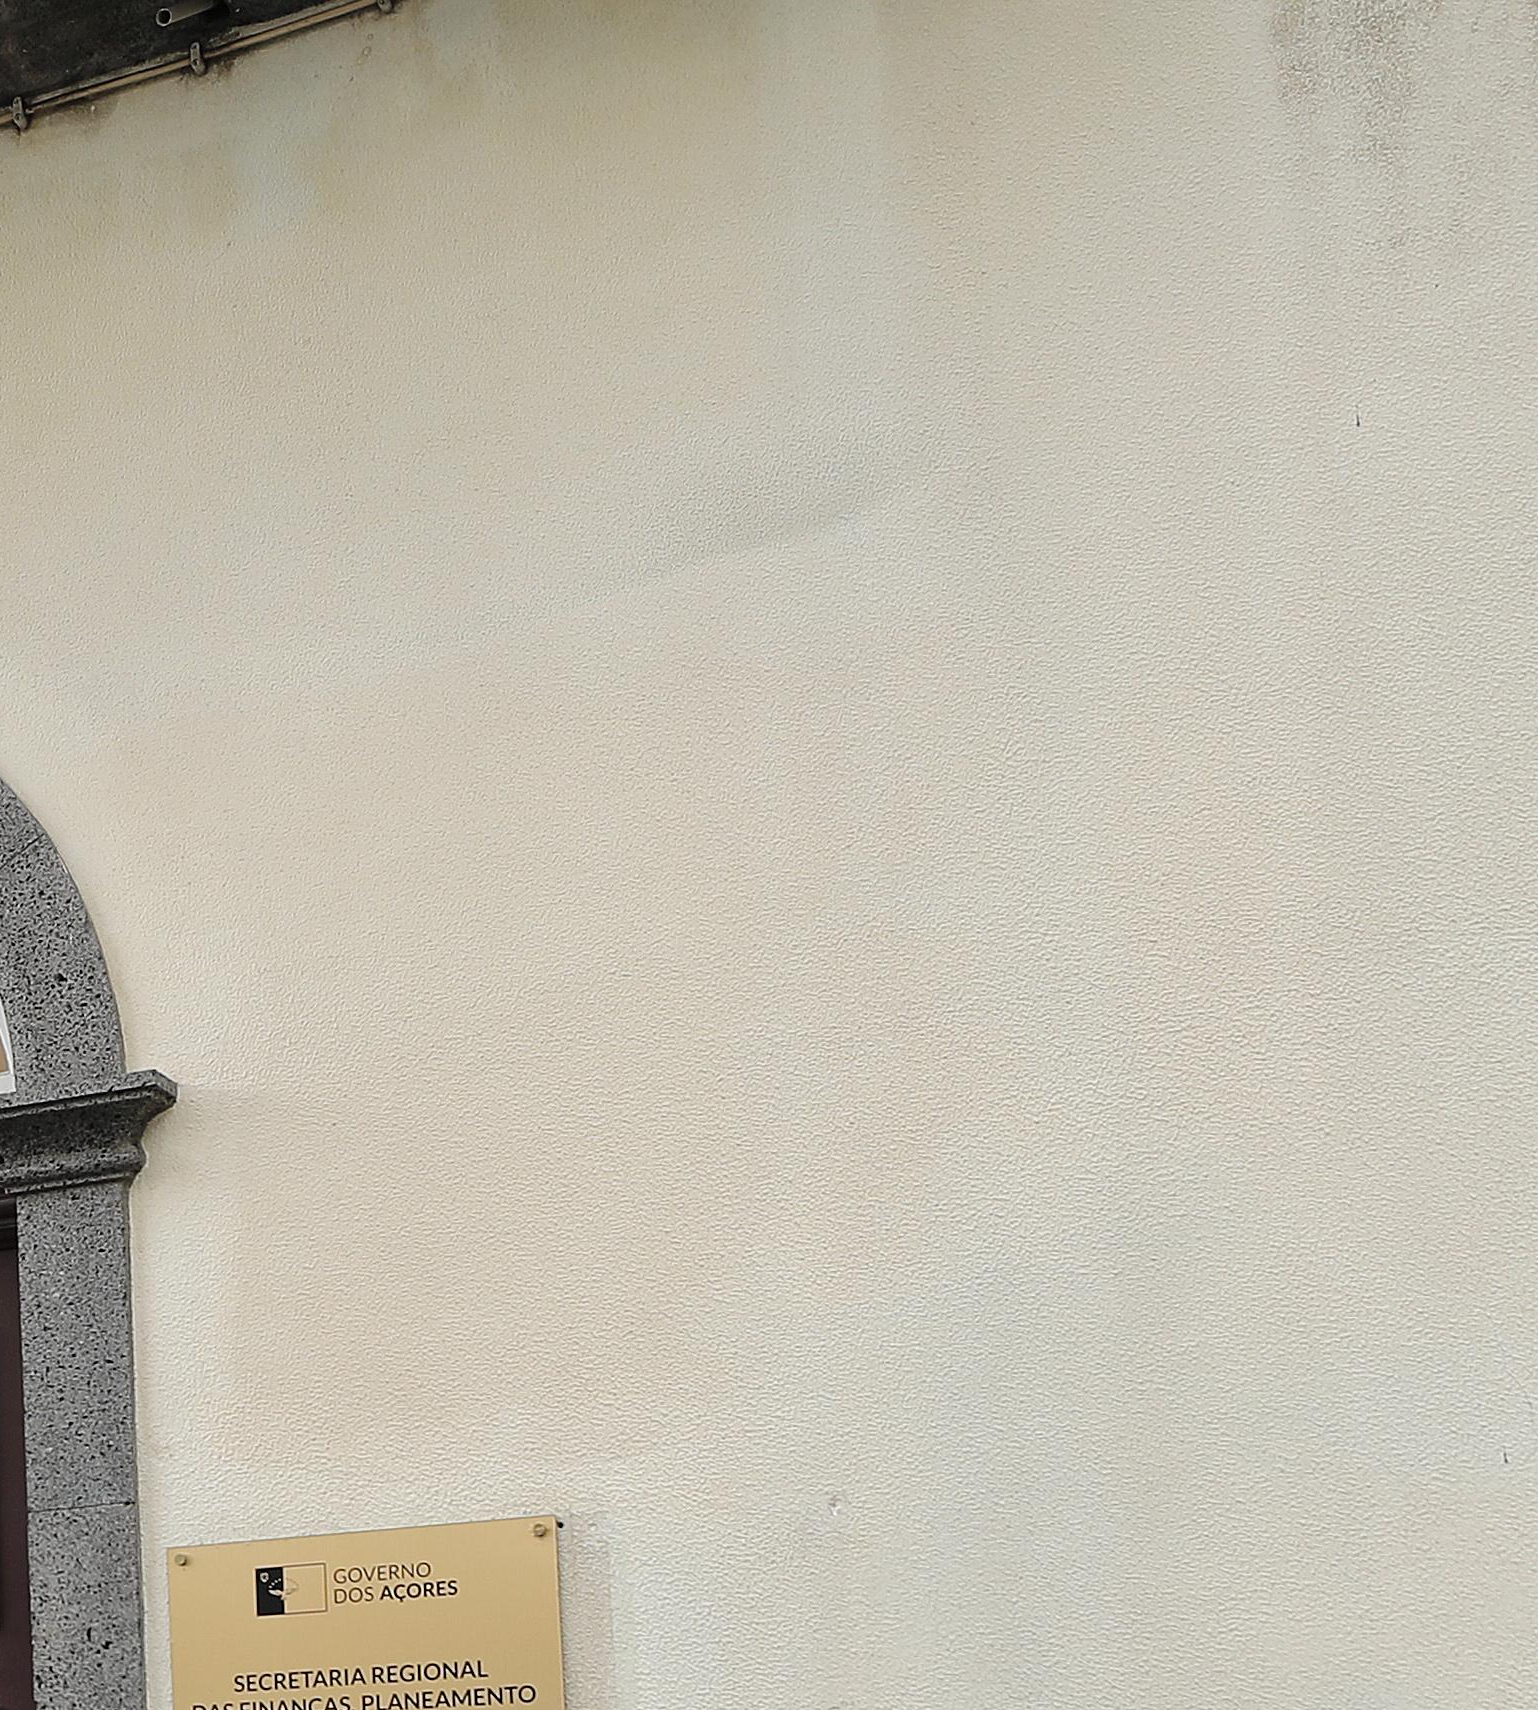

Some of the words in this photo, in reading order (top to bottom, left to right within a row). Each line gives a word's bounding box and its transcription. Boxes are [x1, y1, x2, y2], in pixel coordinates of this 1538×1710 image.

[333, 1562, 431, 1584] GOVERNO
[334, 1586, 374, 1604] DOS
[380, 1580, 458, 1602] AÇORES
[234, 1668, 367, 1692] SECRETARIA
[372, 1660, 489, 1684] REGIONAL
